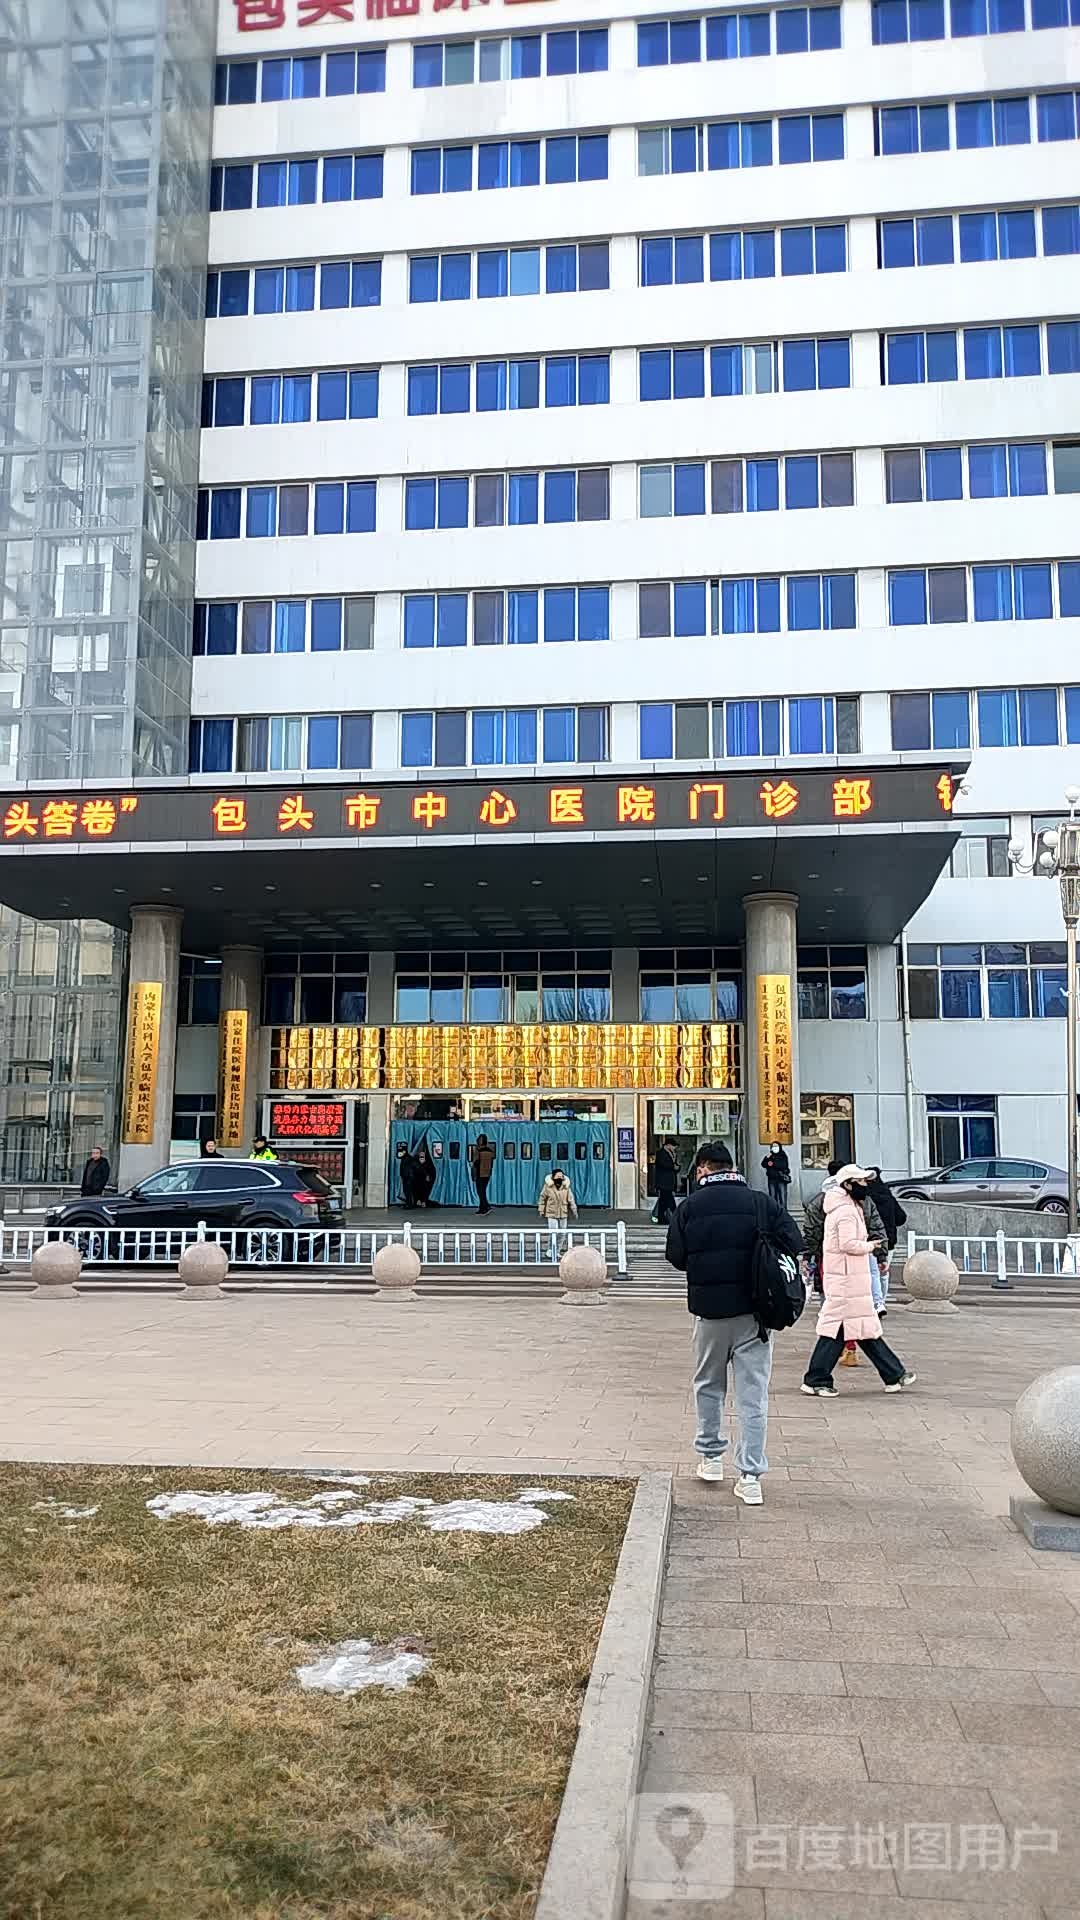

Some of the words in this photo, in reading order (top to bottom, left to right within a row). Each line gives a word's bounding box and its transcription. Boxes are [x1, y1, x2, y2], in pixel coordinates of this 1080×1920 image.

[212, 777, 873, 833] 包头市中心医院门诊部
[774, 984, 790, 1134] 包头医学院中心临床医学院
